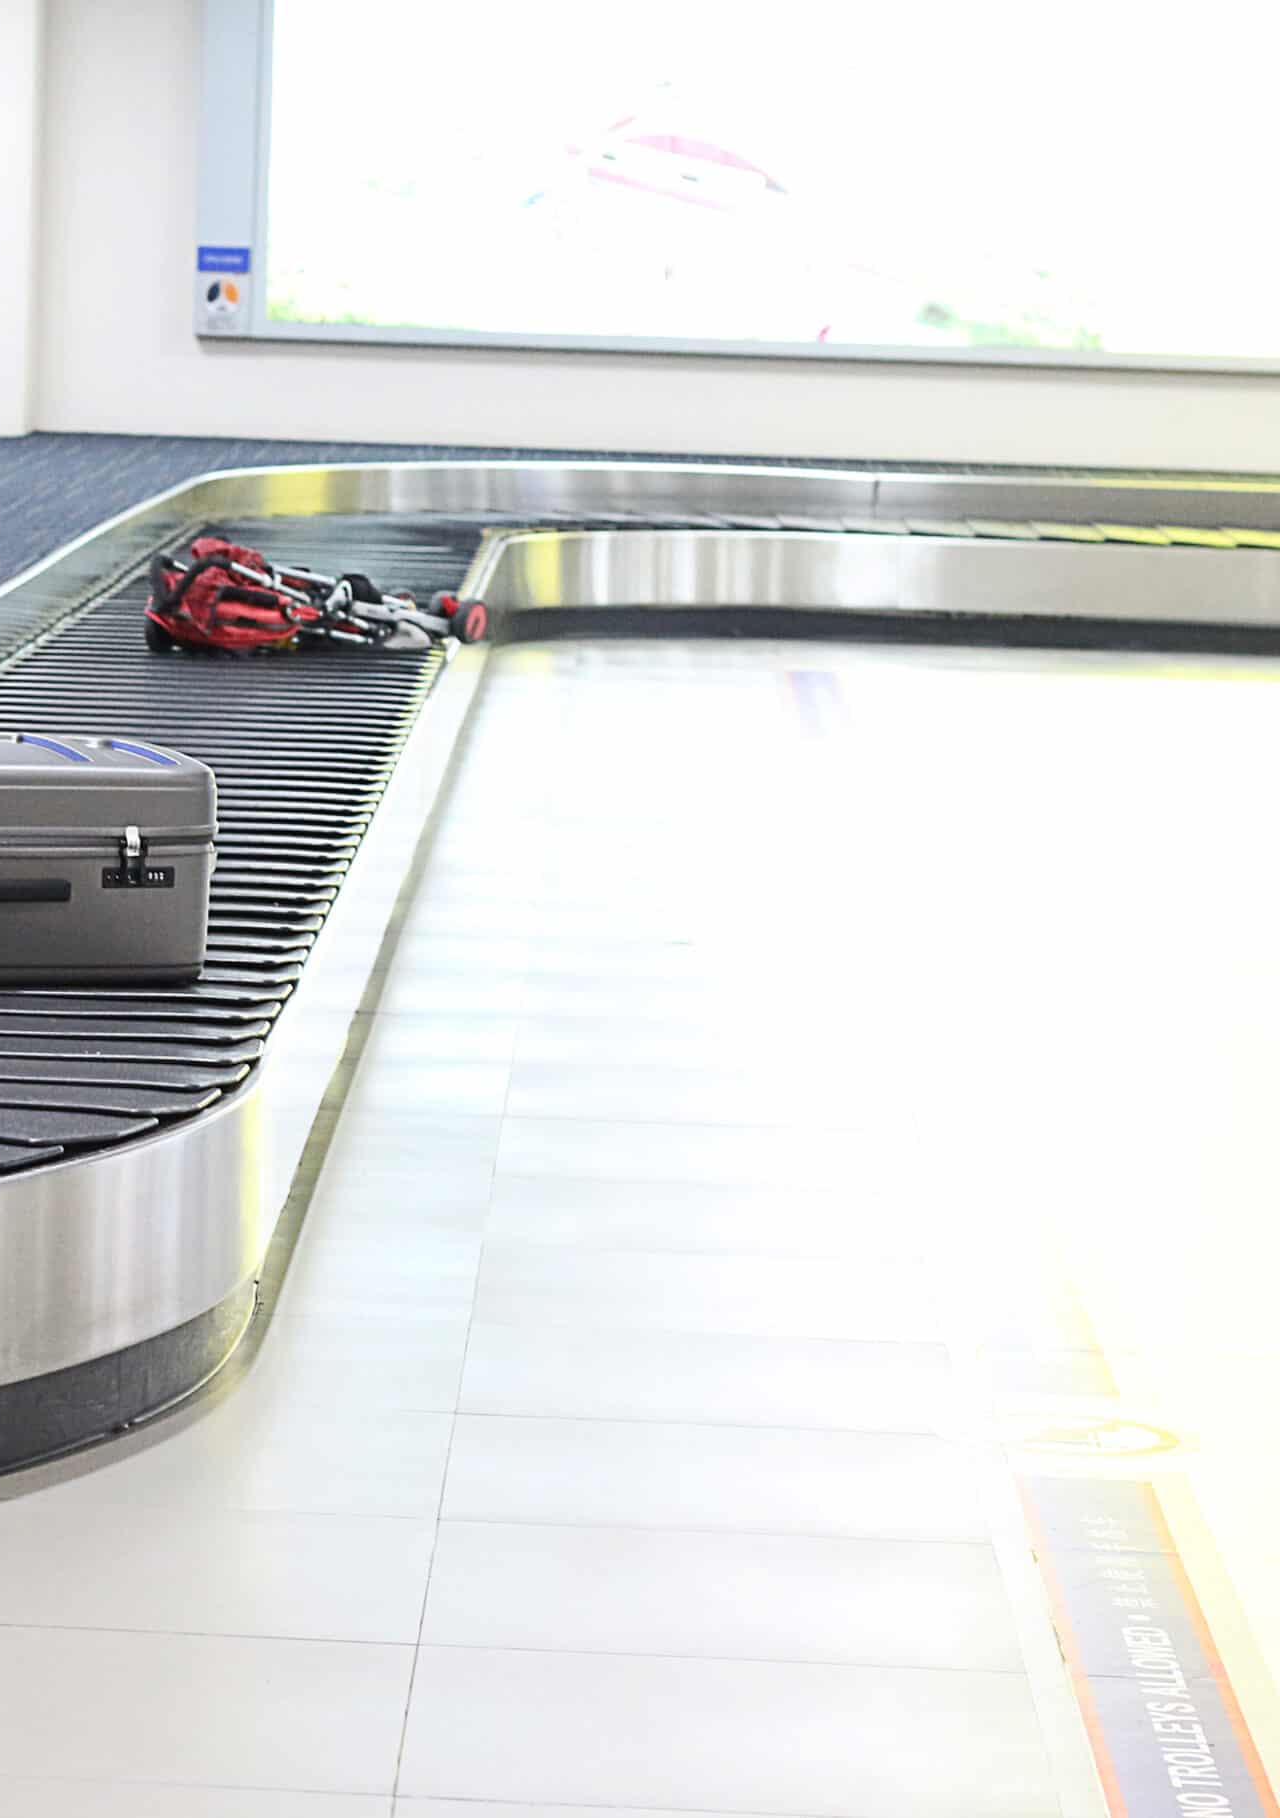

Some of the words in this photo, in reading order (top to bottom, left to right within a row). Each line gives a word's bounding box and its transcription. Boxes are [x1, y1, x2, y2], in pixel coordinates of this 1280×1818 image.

[1120, 1626, 1191, 1699] ALLOWED
[1145, 1701, 1223, 1788] TROLLEYS
[1176, 1792, 1234, 1818] NO
